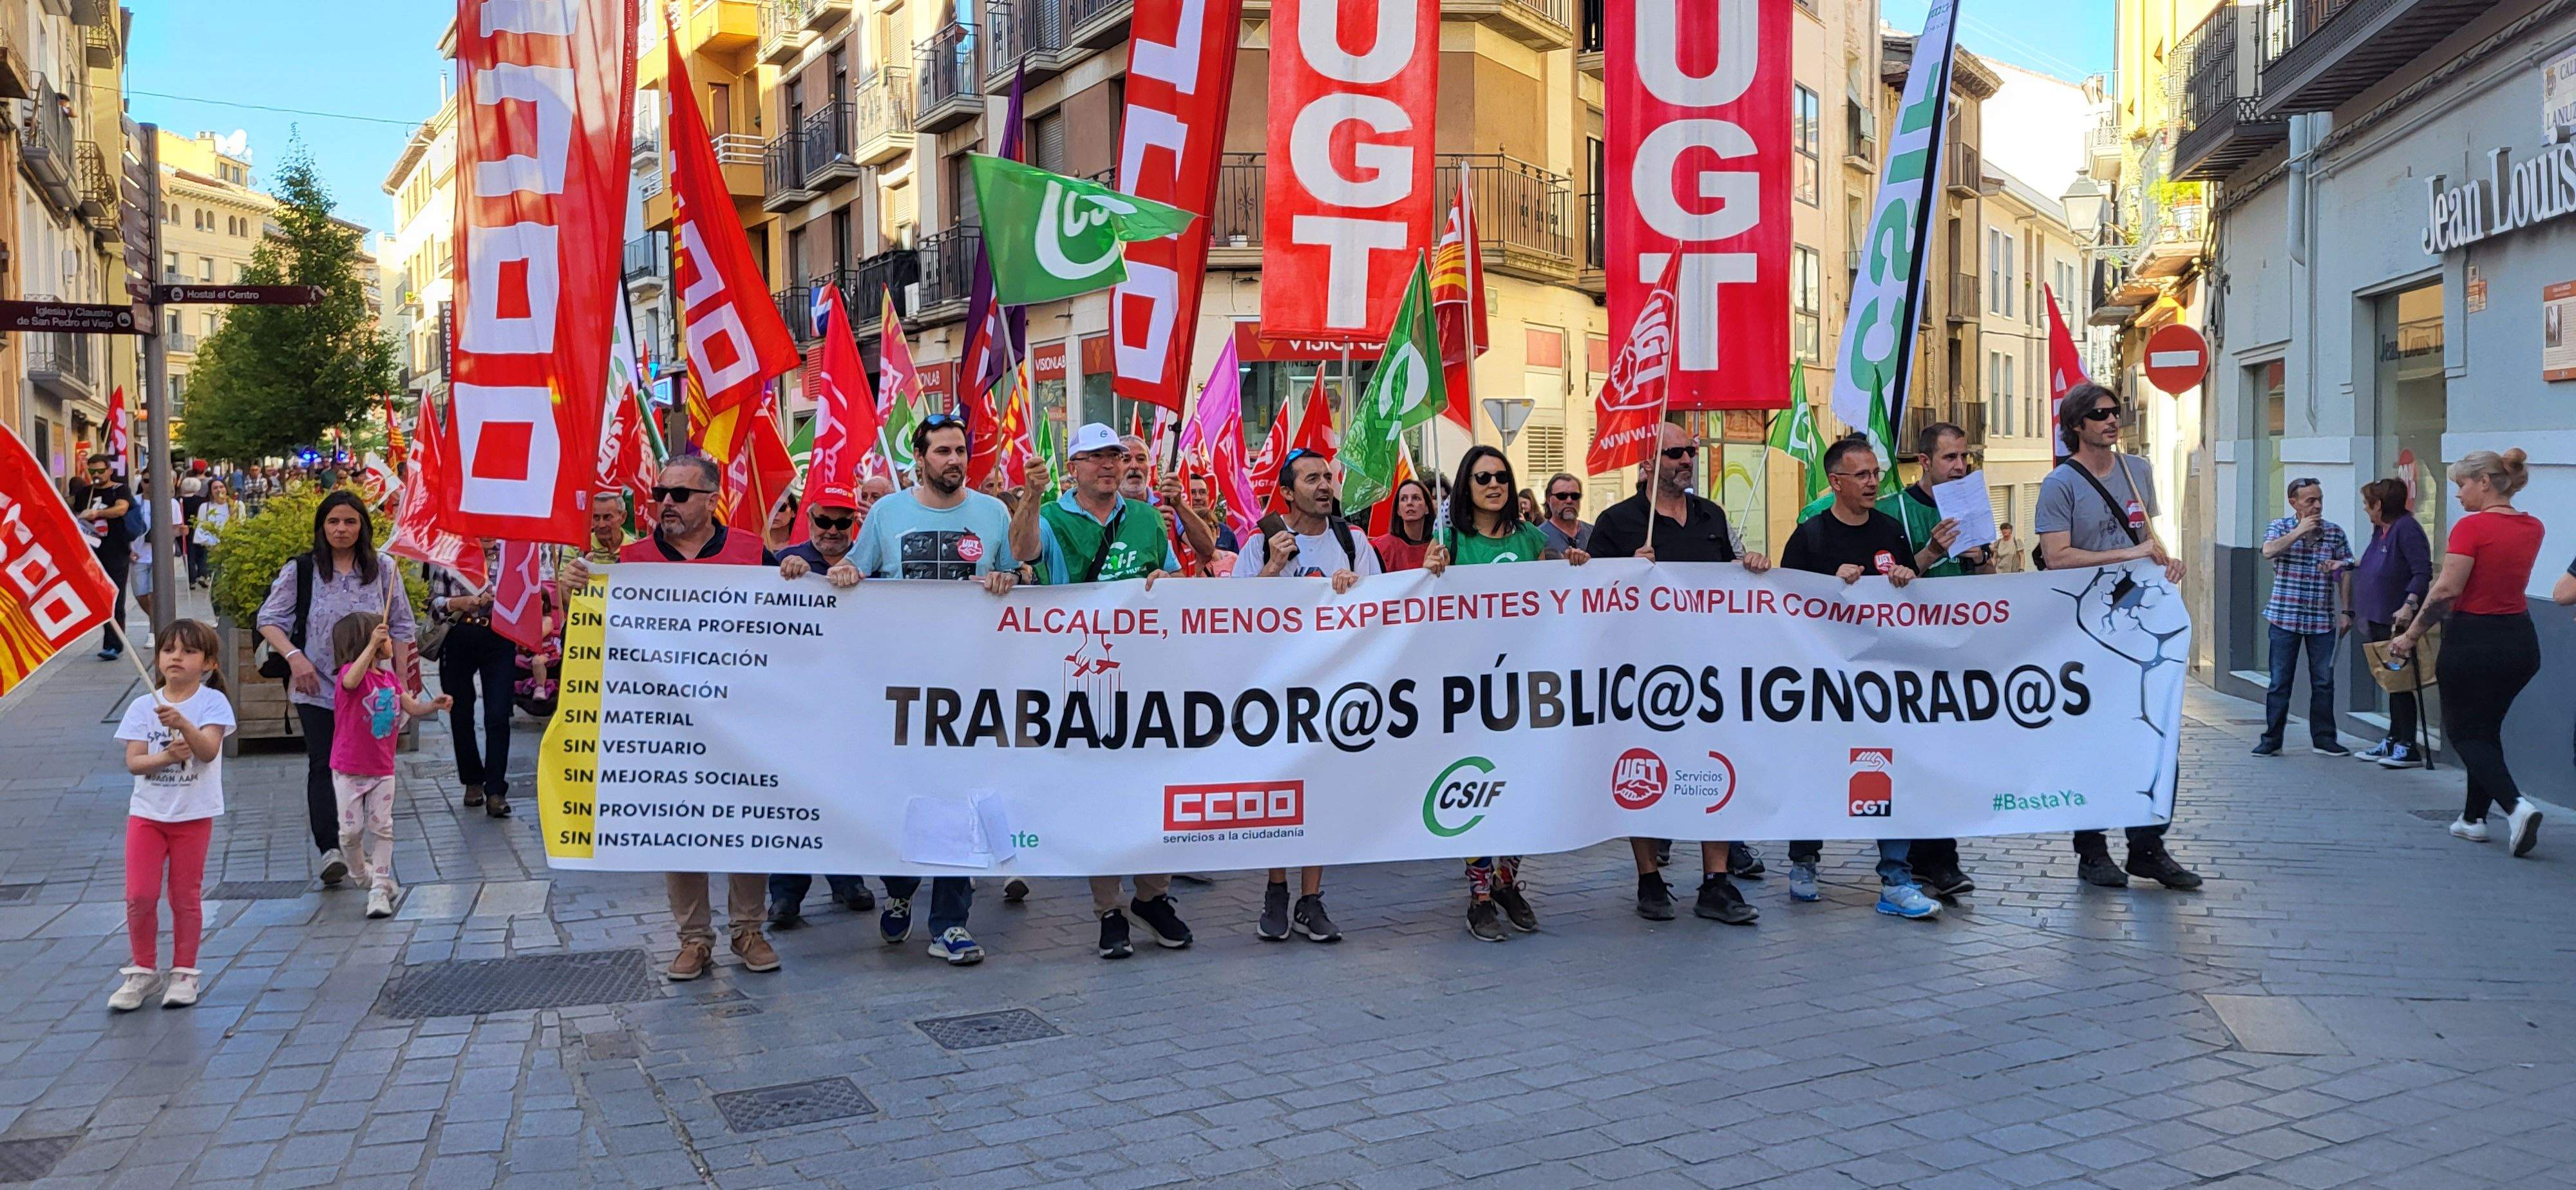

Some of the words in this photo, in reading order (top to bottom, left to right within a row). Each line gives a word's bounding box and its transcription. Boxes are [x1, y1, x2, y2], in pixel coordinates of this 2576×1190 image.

[1290, 0, 1417, 328] UGT
[1632, 0, 1760, 372] UGT
[2422, 175, 2485, 256] Jean
[2487, 128, 2576, 235] Louis
[187, 290, 215, 299] Hostal
[218, 290, 226, 299] el
[228, 290, 259, 299] Centro
[35, 306, 66, 318] Iglesia
[68, 309, 73, 318] y
[75, 307, 113, 317] Claustro
[17, 317, 30, 325] de
[32, 317, 50, 326] San
[53, 317, 79, 326] Pedro
[82, 319, 91, 327] el
[92, 319, 114, 329] Viejo
[1035, 355, 1066, 372] VISIONLAB
[572, 587, 604, 599] SIN
[611, 585, 748, 604] CONCILIACIÓN
[755, 592, 837, 609] FAMILIAR
[997, 607, 1169, 639] ALCALDE,
[1182, 607, 1303, 634] MENOS
[1316, 590, 1540, 632] EXPEDIENTES
[1549, 589, 1571, 614] Y
[1582, 580, 1640, 614] MÁS
[1650, 586, 1777, 614] CUMPLIR
[1783, 593, 2010, 627] COMPROMISOS
[571, 612, 602, 626] SIN
[610, 614, 692, 632] CARRERA
[699, 619, 824, 637] PROFESIONAL
[568, 646, 601, 659] SIN
[608, 647, 768, 667] RECLASIFICACIÓN
[566, 680, 599, 694] SIN
[606, 680, 728, 699] VALORACIÓN
[886, 679, 1418, 752] TRABAJADOR@S
[1443, 653, 1723, 733] PÚBLIC@S
[1741, 661, 2091, 729] IGNORAD@S
[564, 710, 598, 723] SIN
[604, 712, 694, 726] MATERIAL
[563, 739, 596, 753] SIN
[603, 740, 706, 755] VESTUARIO
[564, 768, 594, 782] SIN
[601, 770, 688, 785] MEJORAS
[694, 771, 779, 788] SOCIALES
[1616, 758, 1660, 784] UGT
[1675, 770, 1723, 783] Servicios
[1439, 780, 1507, 810] CSIF
[1674, 783, 1719, 798] Públicos
[1993, 789, 2087, 811] #BastaYa
[562, 801, 592, 816] SIN
[599, 800, 705, 818] PROVISIÓN
[712, 805, 735, 819] DE
[741, 806, 820, 822] PUESTOS
[1173, 788, 1297, 822] CCOO
[1852, 799, 1890, 815] CGT
[560, 831, 591, 845] SIN
[598, 832, 745, 849] INSTALACIONES
[751, 835, 824, 849] DIGNAS
[1163, 833, 1215, 844] servicios
[1227, 831, 1238, 840] la
[1241, 827, 1304, 841] ciudadanía
